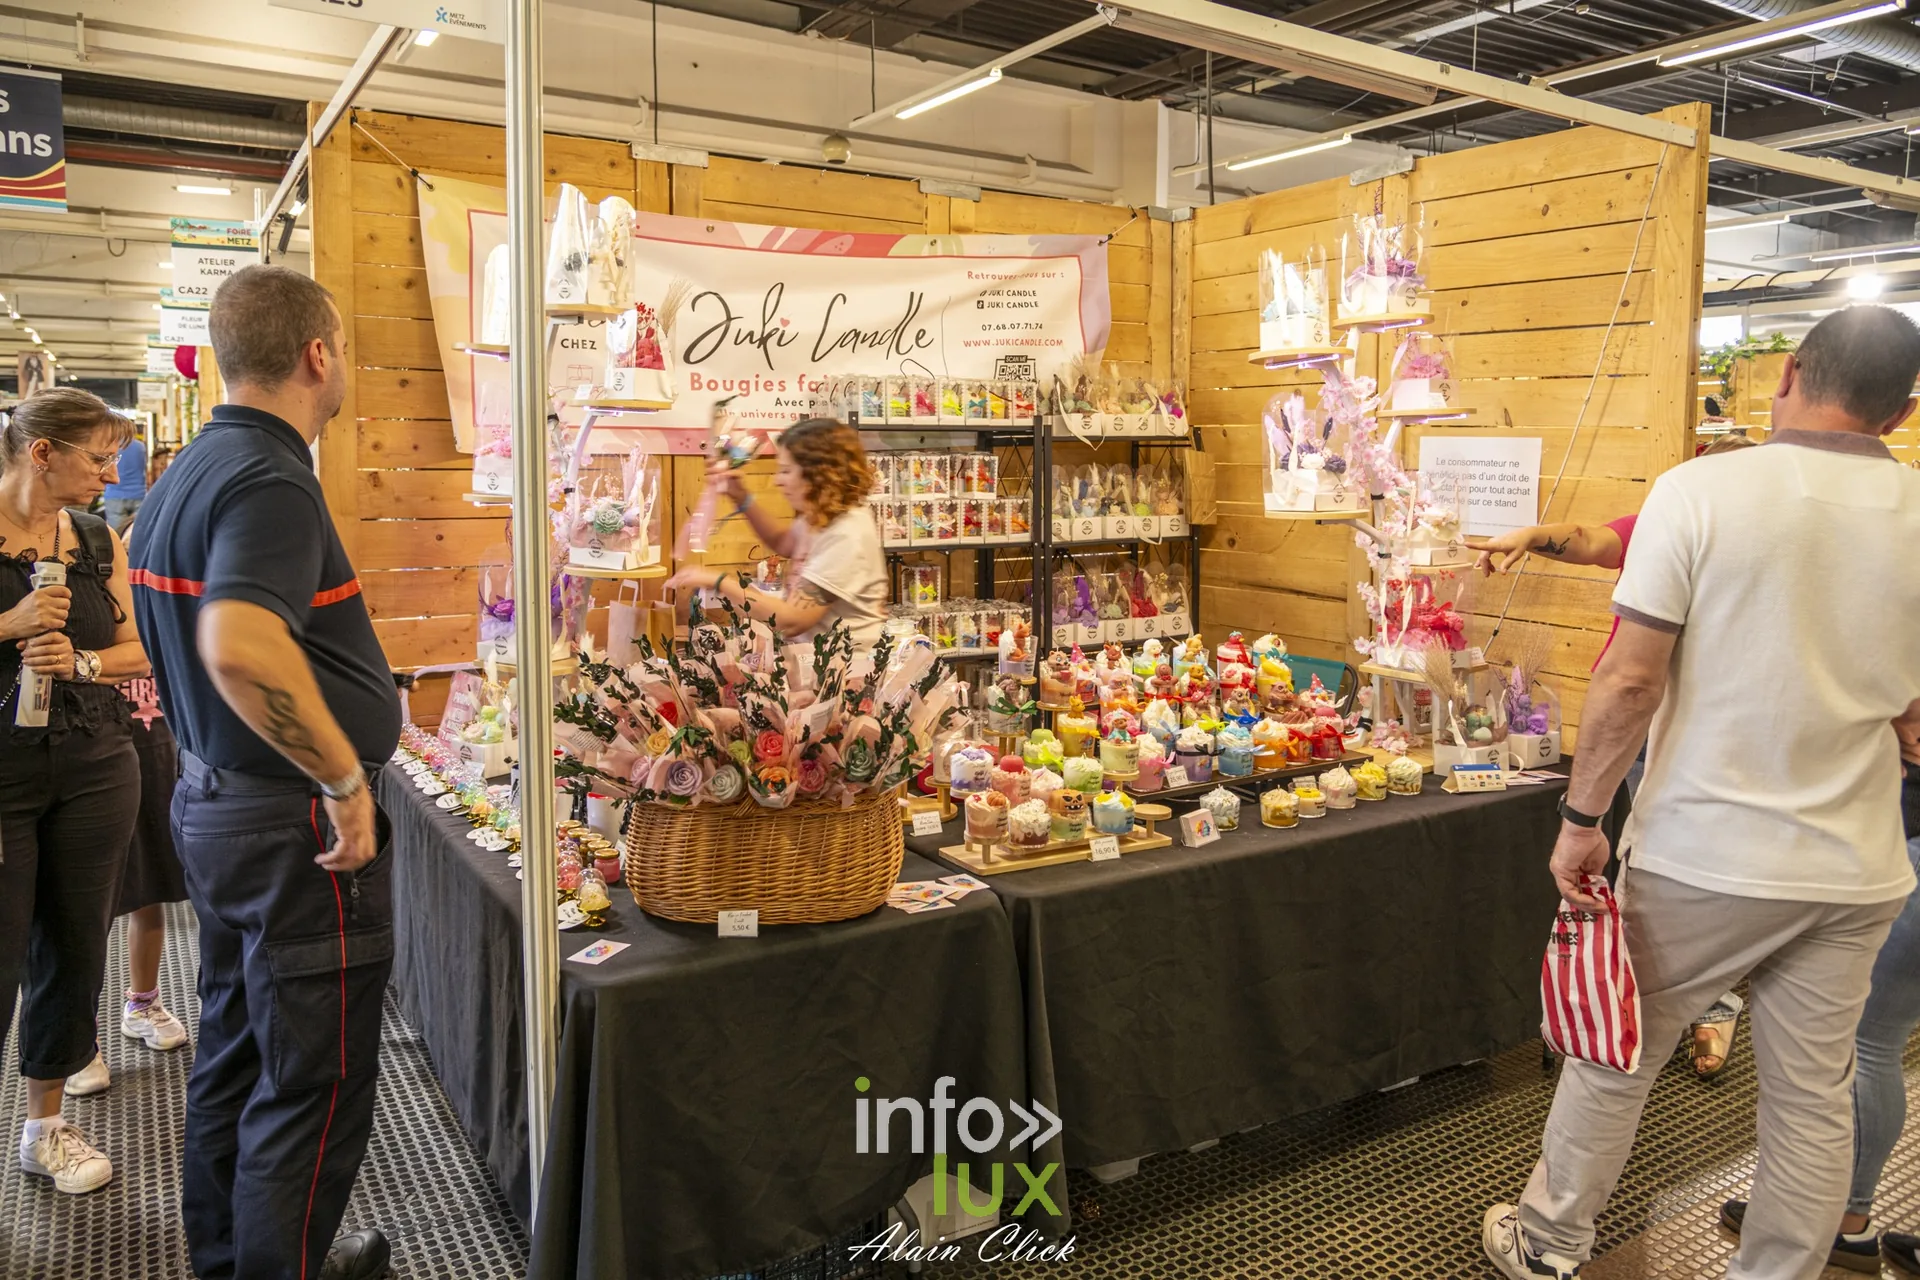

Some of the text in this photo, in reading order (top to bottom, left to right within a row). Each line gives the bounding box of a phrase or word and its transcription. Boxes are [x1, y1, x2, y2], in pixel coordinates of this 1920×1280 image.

[449, 12, 465, 20] METZ
[227, 237, 252, 246] METZ
[198, 258, 235, 266] ATELIER
[200, 268, 234, 276] KARMA
[178, 286, 208, 295] CA22
[987, 300, 1039, 309] JUKI CANDLE
[683, 282, 934, 371] Juki Candle
[560, 338, 597, 350] CHEZ
[963, 338, 1063, 347] WWW.JUKICANDLE.COM
[690, 372, 787, 397] Bougies
[775, 397, 804, 407] Avec
[741, 408, 786, 419] univers
[1436, 457, 1446, 466] Le
[1448, 459, 1507, 468] consommateur
[1461, 473, 1477, 481] pas
[1478, 472, 1496, 481] d'un
[1498, 473, 1517, 482] droit
[1518, 474, 1530, 482] de
[1469, 486, 1488, 494] pour
[1489, 486, 1505, 495] tout
[1507, 487, 1531, 496] achat
[1467, 498, 1480, 506] sur
[1482, 499, 1493, 507] ce
[1494, 499, 1518, 508] stand
